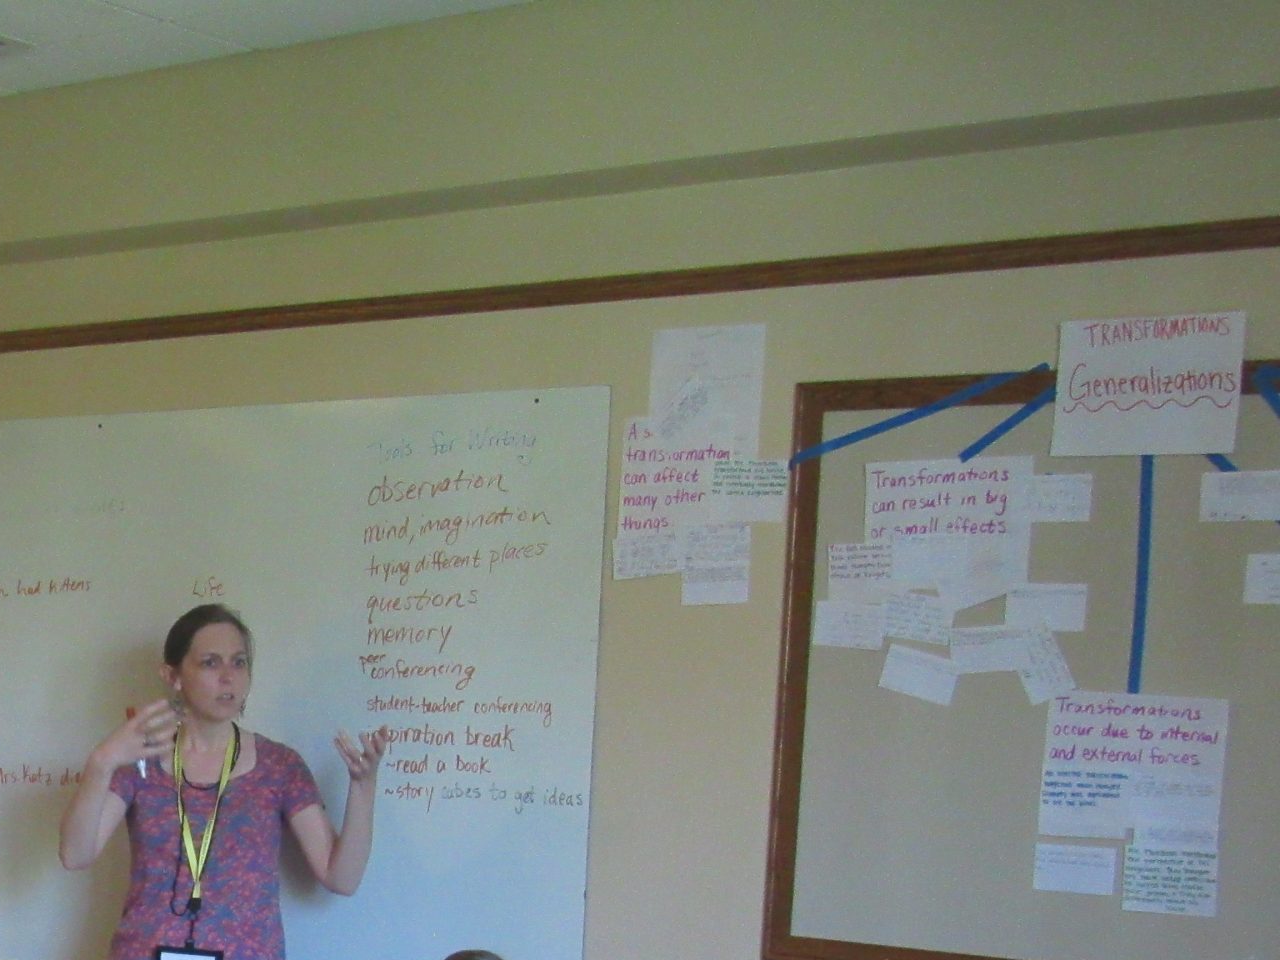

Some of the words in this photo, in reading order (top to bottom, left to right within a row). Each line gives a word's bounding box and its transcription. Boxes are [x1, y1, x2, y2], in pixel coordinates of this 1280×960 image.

[1083, 316, 1230, 348] TRANSFORMATIONS
[1069, 362, 1236, 401] Generalizations
[627, 422, 637, 441] A
[626, 443, 730, 462] transormation
[368, 469, 509, 505] observation
[624, 472, 647, 485] can
[653, 466, 699, 484] affect
[871, 467, 1009, 489] Transformations
[623, 495, 658, 512] many
[664, 488, 706, 506] other
[872, 500, 895, 514] can
[902, 492, 951, 511] result
[960, 495, 976, 507] in
[985, 489, 1008, 516] big
[419, 507, 551, 546] imagination
[621, 516, 669, 533] things
[871, 526, 886, 540] or
[894, 516, 938, 536] small
[946, 516, 1007, 535] effects
[366, 555, 410, 586] trying
[415, 549, 481, 574] different
[489, 542, 548, 573] places
[366, 589, 478, 624] questions
[367, 625, 452, 654] memory
[359, 653, 386, 674] peer
[371, 658, 476, 690] conferencing
[366, 695, 464, 713] student-teacher
[474, 695, 552, 728] conferencing
[1055, 696, 1202, 721] Transformations
[465, 724, 516, 752] break
[1052, 724, 1094, 737] occur
[1101, 723, 1129, 740] due
[1136, 723, 1154, 741] to
[1160, 725, 1219, 745] internal
[437, 760, 446, 773] a
[456, 754, 491, 774] book
[1049, 744, 1076, 761] and
[1082, 746, 1143, 764] external
[1150, 746, 1201, 766] forces
[441, 782, 481, 799] cubes
[489, 782, 507, 801] to
[514, 785, 535, 814] get
[543, 787, 583, 806] ideas
